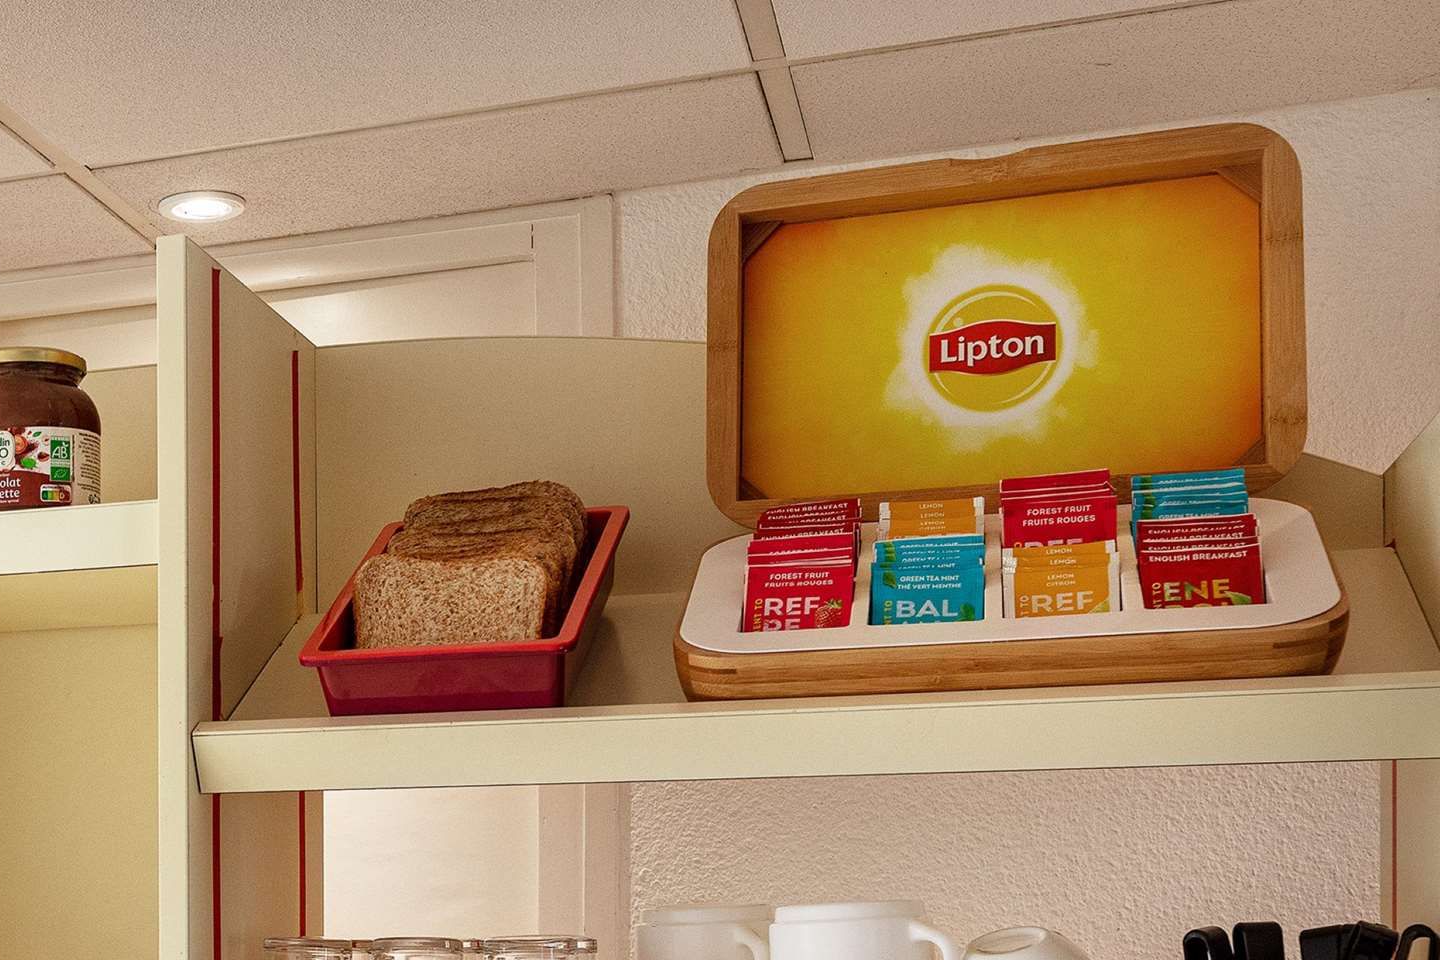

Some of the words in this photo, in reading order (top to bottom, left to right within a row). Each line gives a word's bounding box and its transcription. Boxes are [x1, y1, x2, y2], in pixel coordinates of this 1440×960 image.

[941, 334, 1045, 367] Lipton
[52, 446, 68, 459] AB
[1027, 507, 1062, 516] FOREST
[1065, 504, 1092, 513] FRUIT
[1022, 516, 1055, 527] FRUITS
[1057, 514, 1096, 524] ROUGES
[1045, 547, 1072, 555] LEMON
[1149, 554, 1190, 562] ENGLISH
[1192, 550, 1248, 560] BREAKFAST
[1050, 558, 1077, 566] LEMON
[770, 572, 802, 580] FOREST
[805, 571, 830, 579] FRUIT
[1163, 578, 1230, 602] ENE
[764, 596, 820, 616] REF
[1031, 591, 1094, 613] REF
[896, 600, 958, 618] BAL
